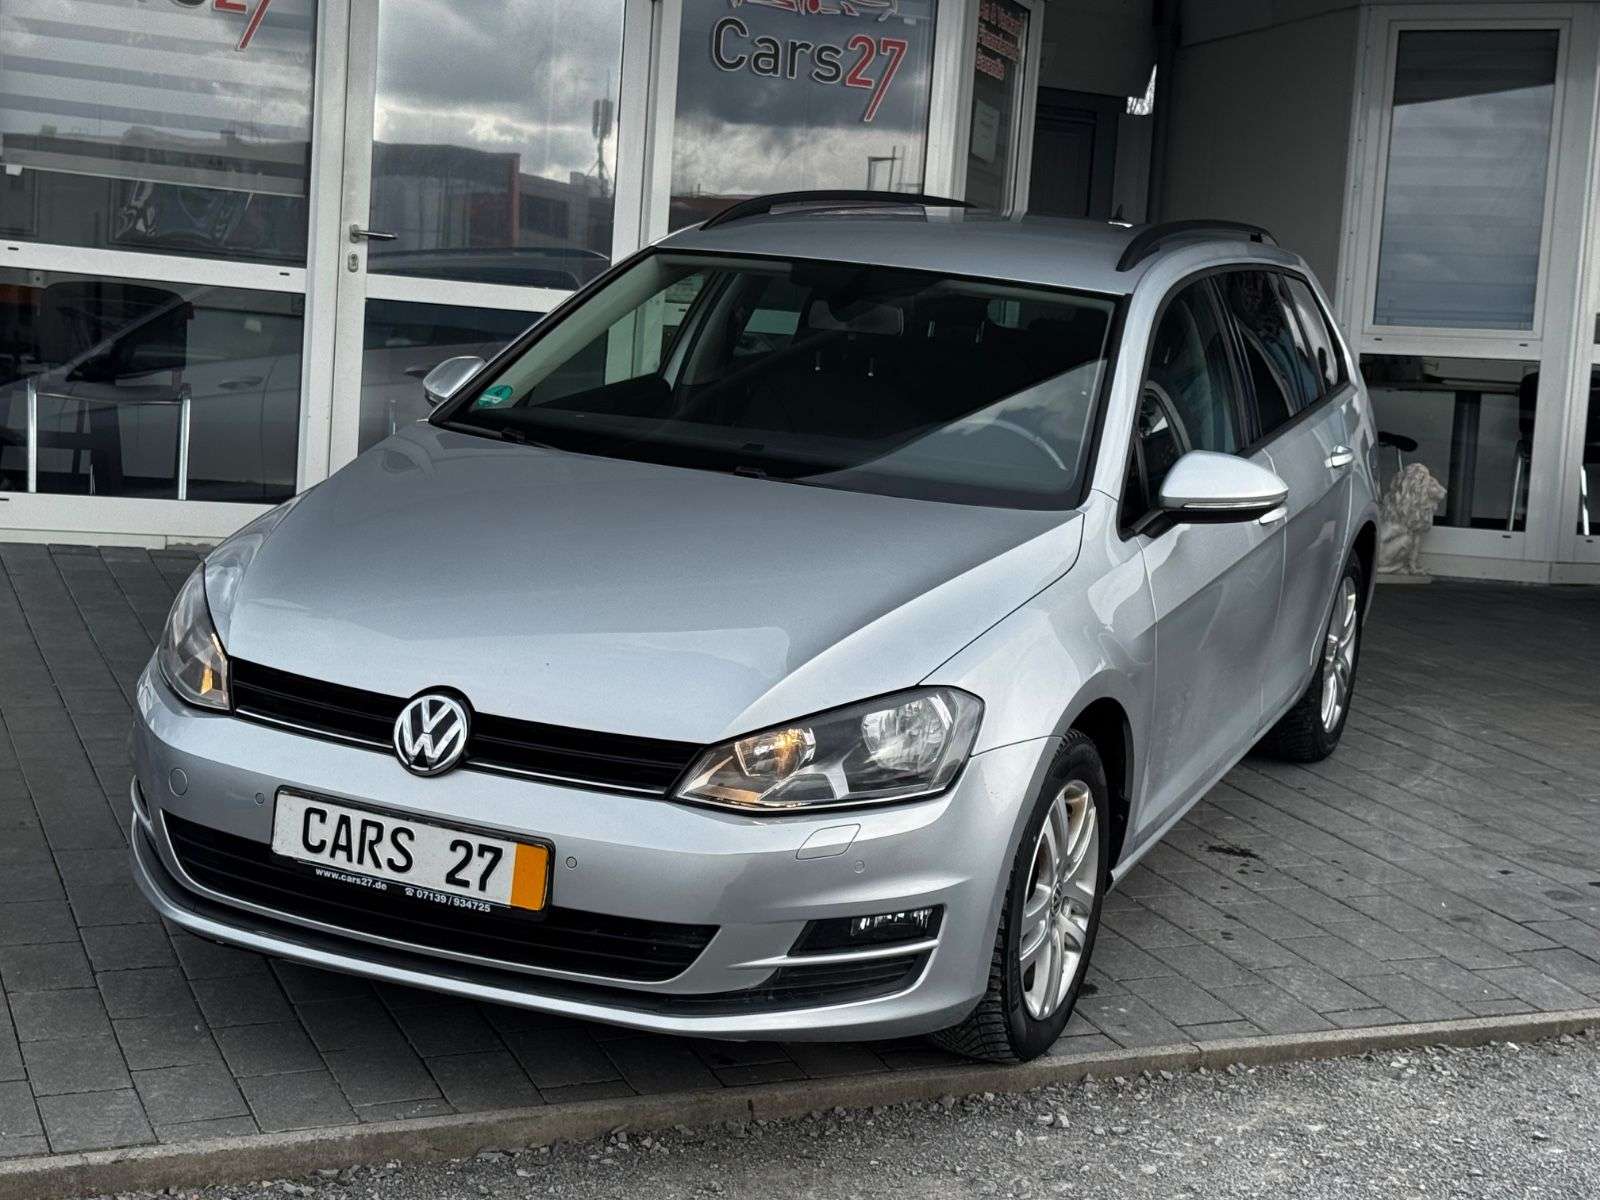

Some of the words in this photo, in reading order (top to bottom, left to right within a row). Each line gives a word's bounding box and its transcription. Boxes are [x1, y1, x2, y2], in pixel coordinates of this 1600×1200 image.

[712, 16, 908, 122] Cars27
[302, 806, 415, 874] CARS
[445, 839, 503, 892] 27
[315, 868, 387, 890] www.cars27.de
[416, 890, 447, 904] 07139
[453, 898, 491, 912] 934725
